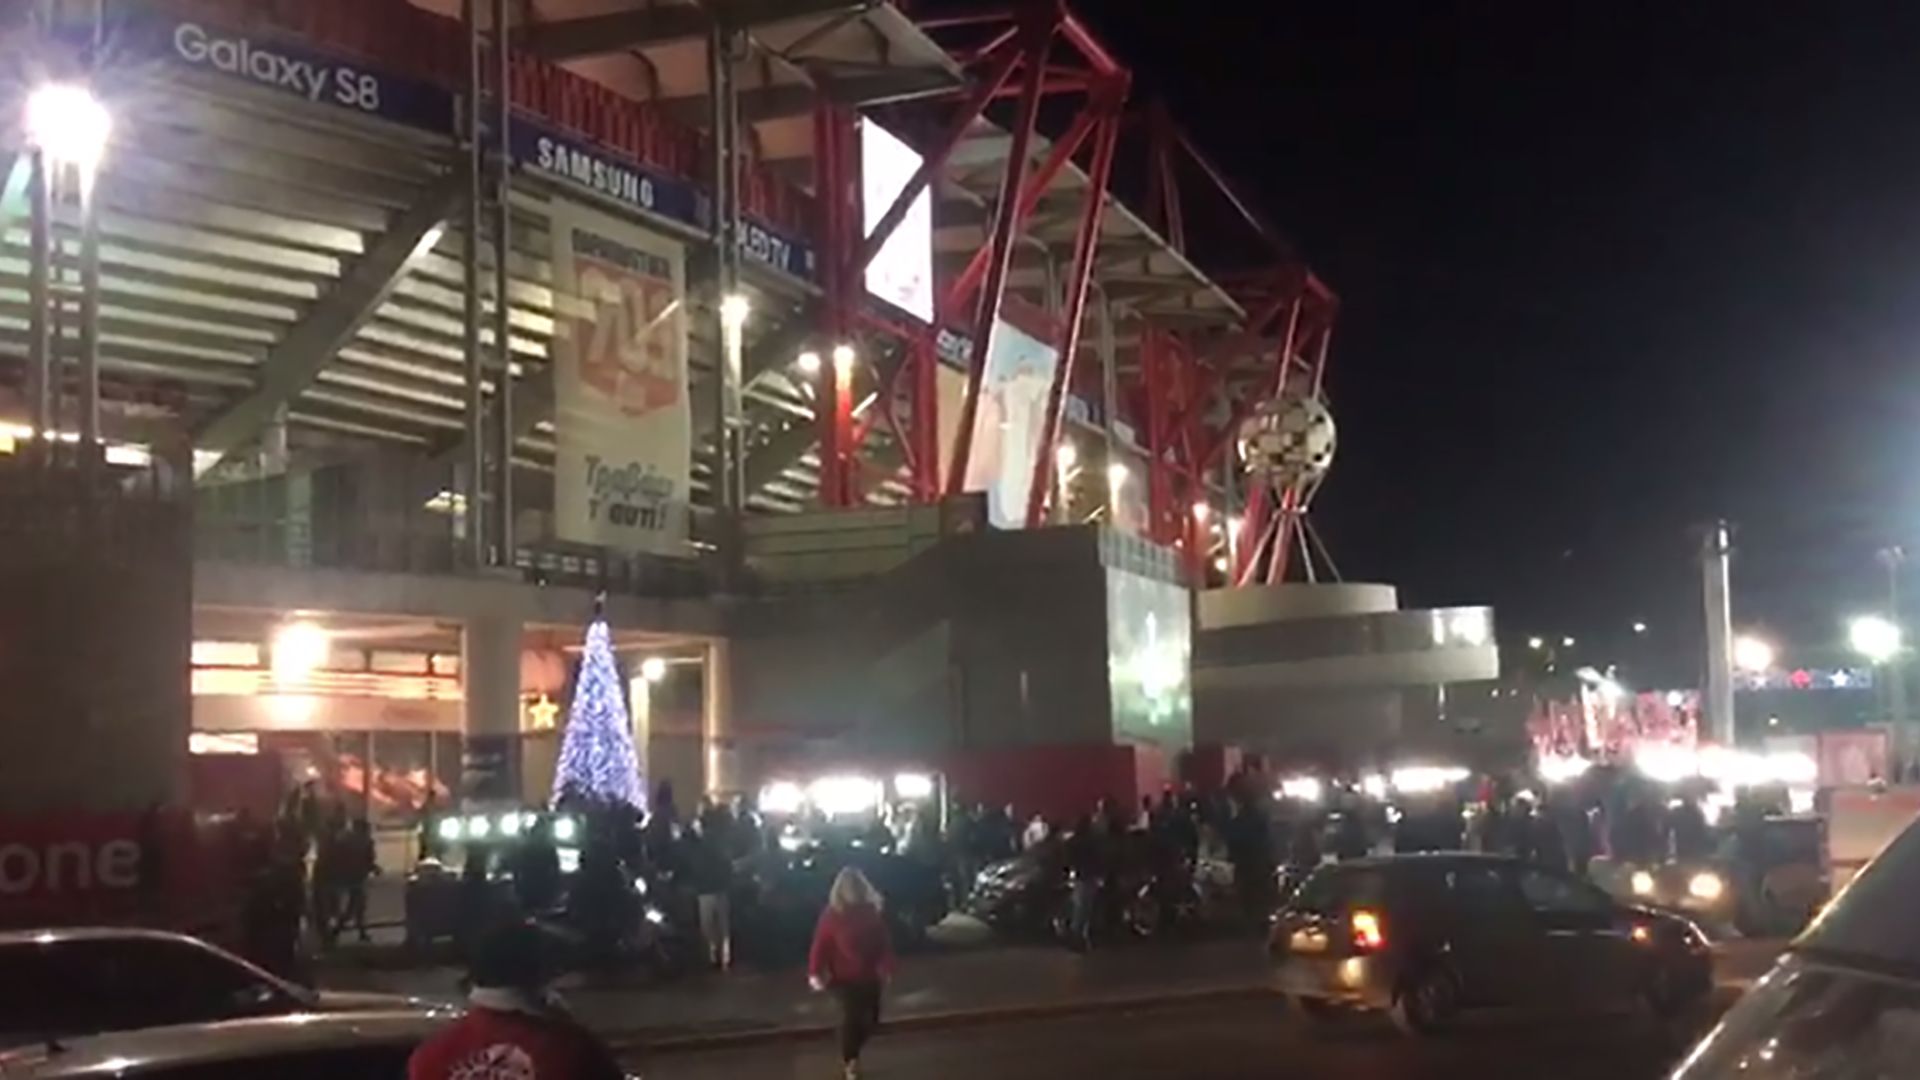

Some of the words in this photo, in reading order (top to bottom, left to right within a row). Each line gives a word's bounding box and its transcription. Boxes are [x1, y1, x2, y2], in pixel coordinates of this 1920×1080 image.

[174, 22, 328, 101] Galaxy
[335, 67, 380, 110] S8
[537, 137, 654, 207] SAMSUNG
[0, 838, 142, 893] one
